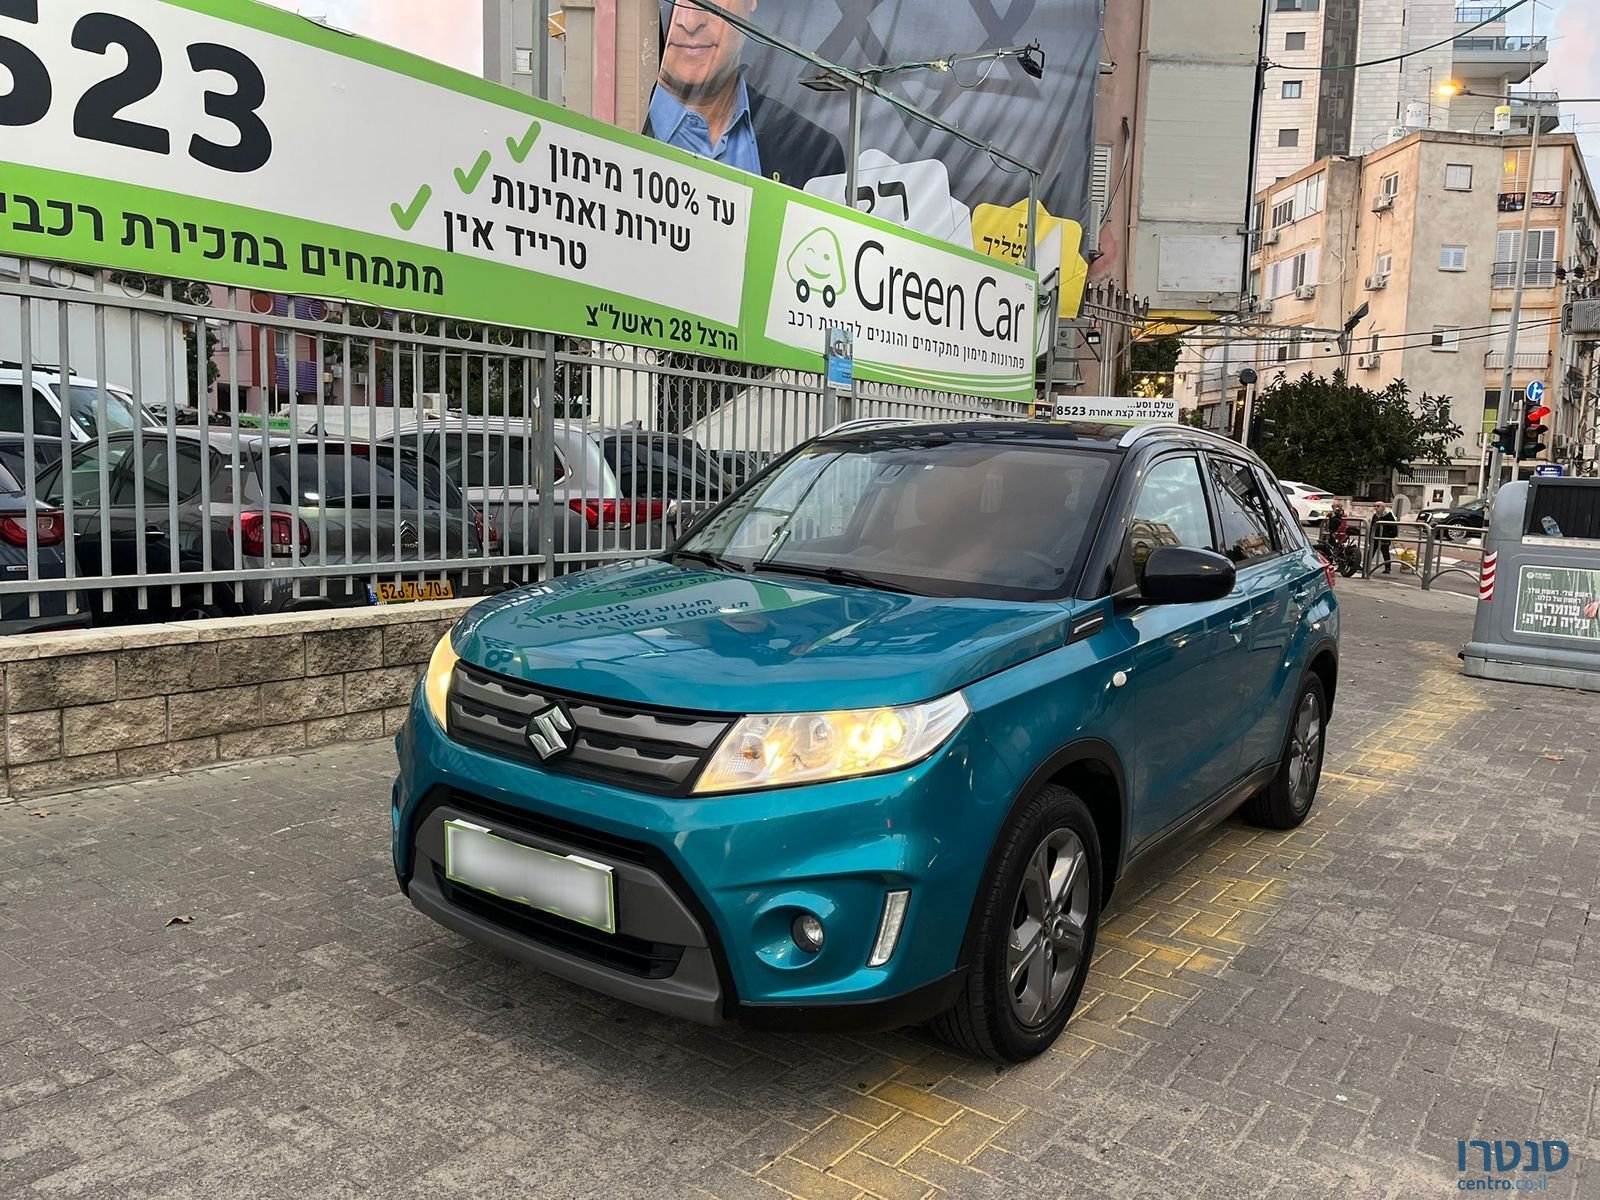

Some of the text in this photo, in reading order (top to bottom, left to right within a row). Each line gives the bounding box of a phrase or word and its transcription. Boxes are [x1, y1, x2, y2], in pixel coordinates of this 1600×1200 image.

[549, 144, 735, 226] עד 100% מימון
[492, 174, 690, 252] שירות ואמינות
[121, 211, 288, 270] במכירת
[443, 211, 587, 269] טרייד אין
[302, 243, 444, 296] מתמחים
[855, 240, 1024, 344] Green Car
[788, 310, 813, 329] רכב
[669, 318, 692, 342] 28
[697, 321, 738, 351] הרצל
[867, 327, 907, 347] והוגנים
[913, 337, 959, 357] מתקדמים
[963, 347, 987, 363] מימון
[991, 354, 1025, 370] פתרונות
[1056, 406, 1173, 419] אצלנו זה קצת אחרת 8523
[1154, 401, 1174, 409] שלם
[1534, 602, 1580, 616] שומרים
[1522, 613, 1558, 627] נקייה!
